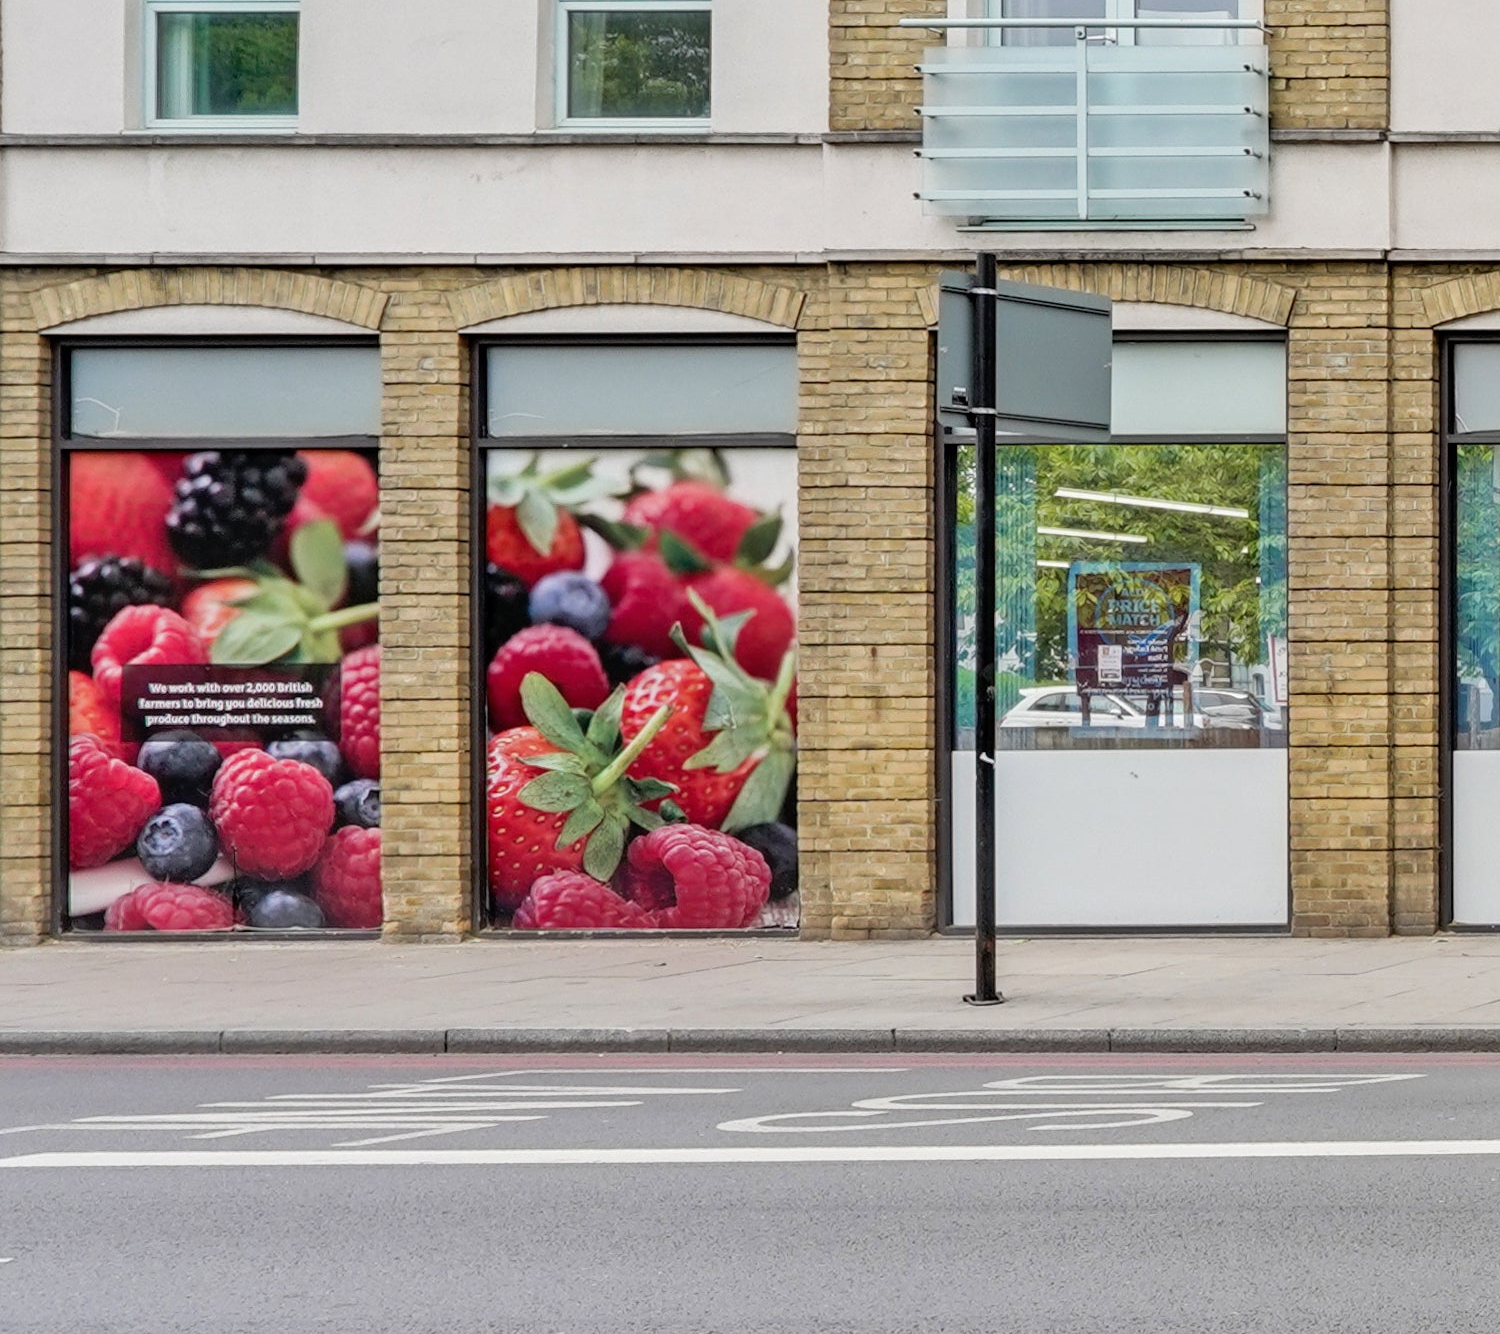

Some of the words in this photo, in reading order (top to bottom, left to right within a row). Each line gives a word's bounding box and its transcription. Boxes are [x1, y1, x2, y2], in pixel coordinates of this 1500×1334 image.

[149, 683, 166, 693] We
[168, 683, 194, 693] work
[197, 682, 220, 693] with
[222, 685, 245, 693] over
[246, 683, 275, 695] 2,000
[276, 682, 312, 693] British
[138, 698, 180, 709] farmers
[182, 699, 194, 709] to
[195, 698, 224, 711] bring
[225, 700, 246, 711] you
[247, 698, 294, 709] delicious
[295, 698, 323, 709] fresh
[146, 714, 190, 727] produce
[191, 714, 250, 727] throughout
[252, 714, 270, 724] the
[271, 715, 316, 725] seasons.
